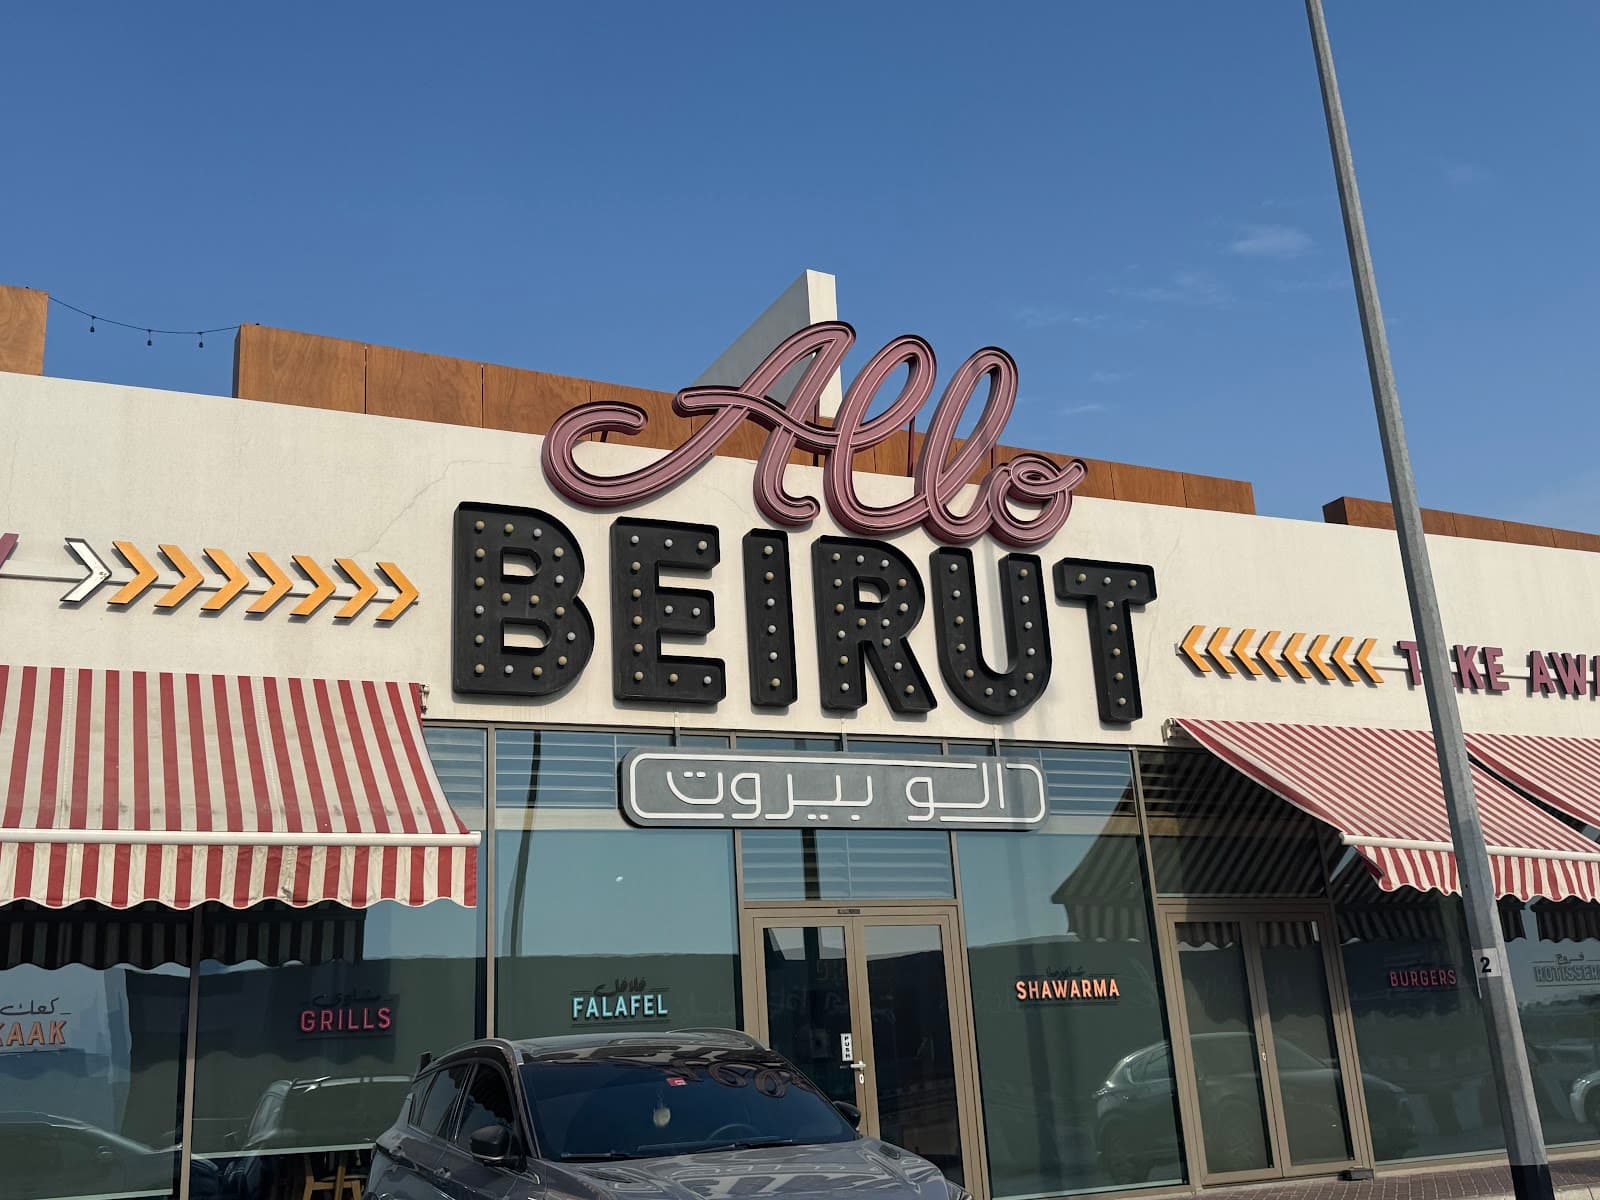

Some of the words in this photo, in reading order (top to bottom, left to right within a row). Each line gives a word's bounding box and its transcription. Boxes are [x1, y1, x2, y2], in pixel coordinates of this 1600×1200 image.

[542, 320, 1087, 547] Allo
[453, 501, 1157, 724] BEIRUT
[1397, 640, 1510, 692] TKE
[1529, 650, 1600, 697] AW
[666, 771, 874, 820] بيروت
[1479, 956, 1492, 973] 2
[1015, 978, 1120, 1001] SHAWARMA
[1389, 969, 1457, 987] BURGERS
[299, 1007, 393, 1033] GRILLS
[572, 994, 669, 1020] FALAFEL
